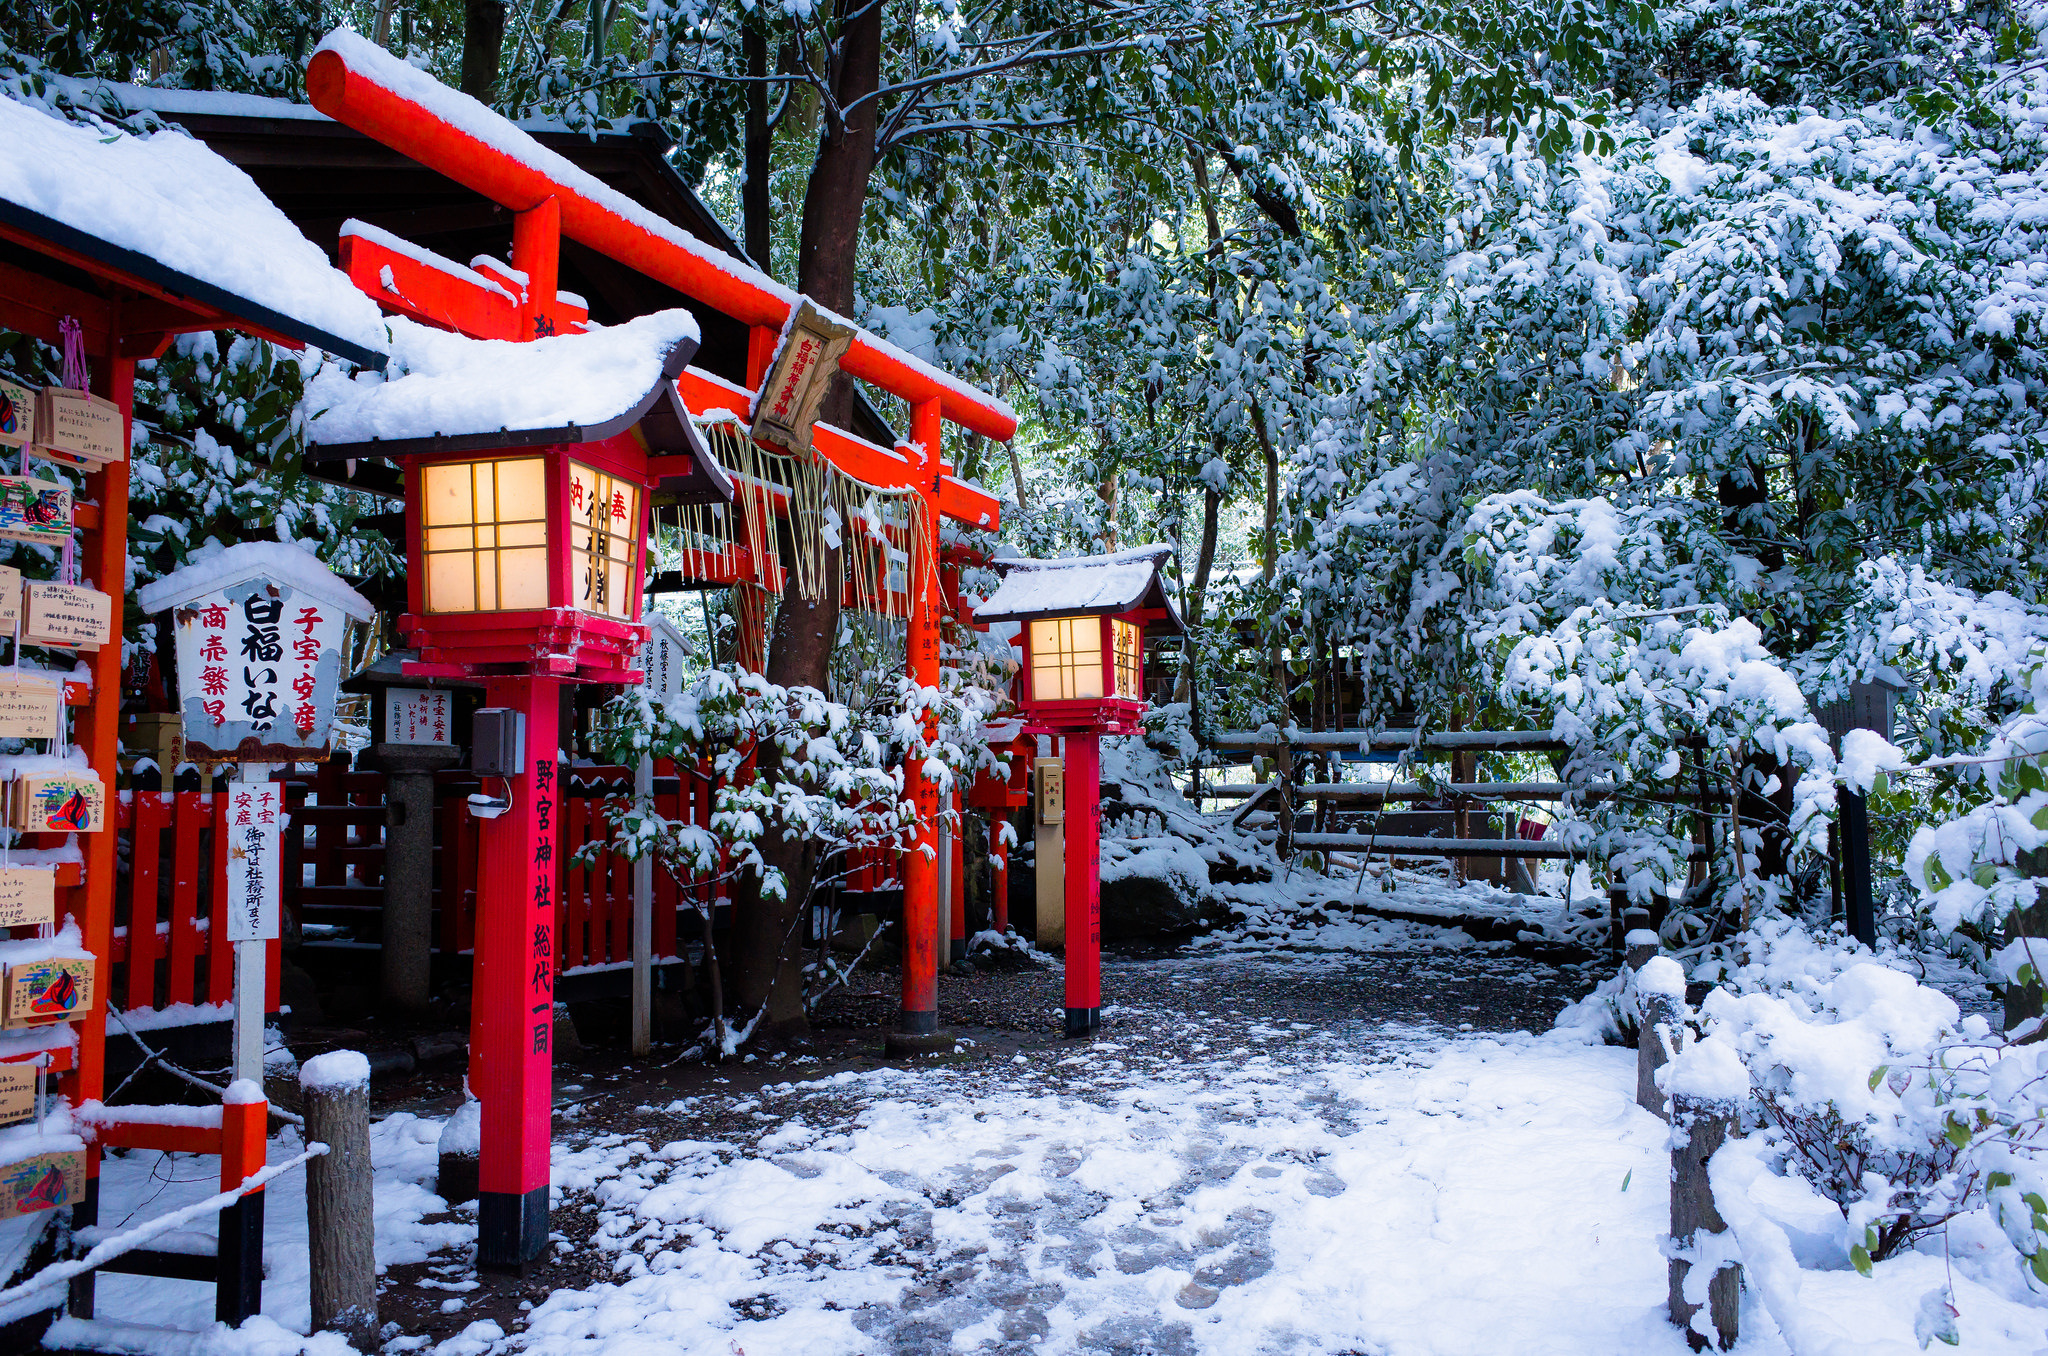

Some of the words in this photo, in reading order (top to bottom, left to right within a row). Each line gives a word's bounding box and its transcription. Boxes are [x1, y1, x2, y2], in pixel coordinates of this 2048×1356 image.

[611, 490, 627, 524] 奉
[93, 791, 101, 824] 子宝安産
[533, 759, 554, 910] 野宮神社
[244, 826, 266, 929] 御守は社務所まで
[81, 969, 90, 1002] 子宝安産
[531, 923, 551, 1056] 総代一同
